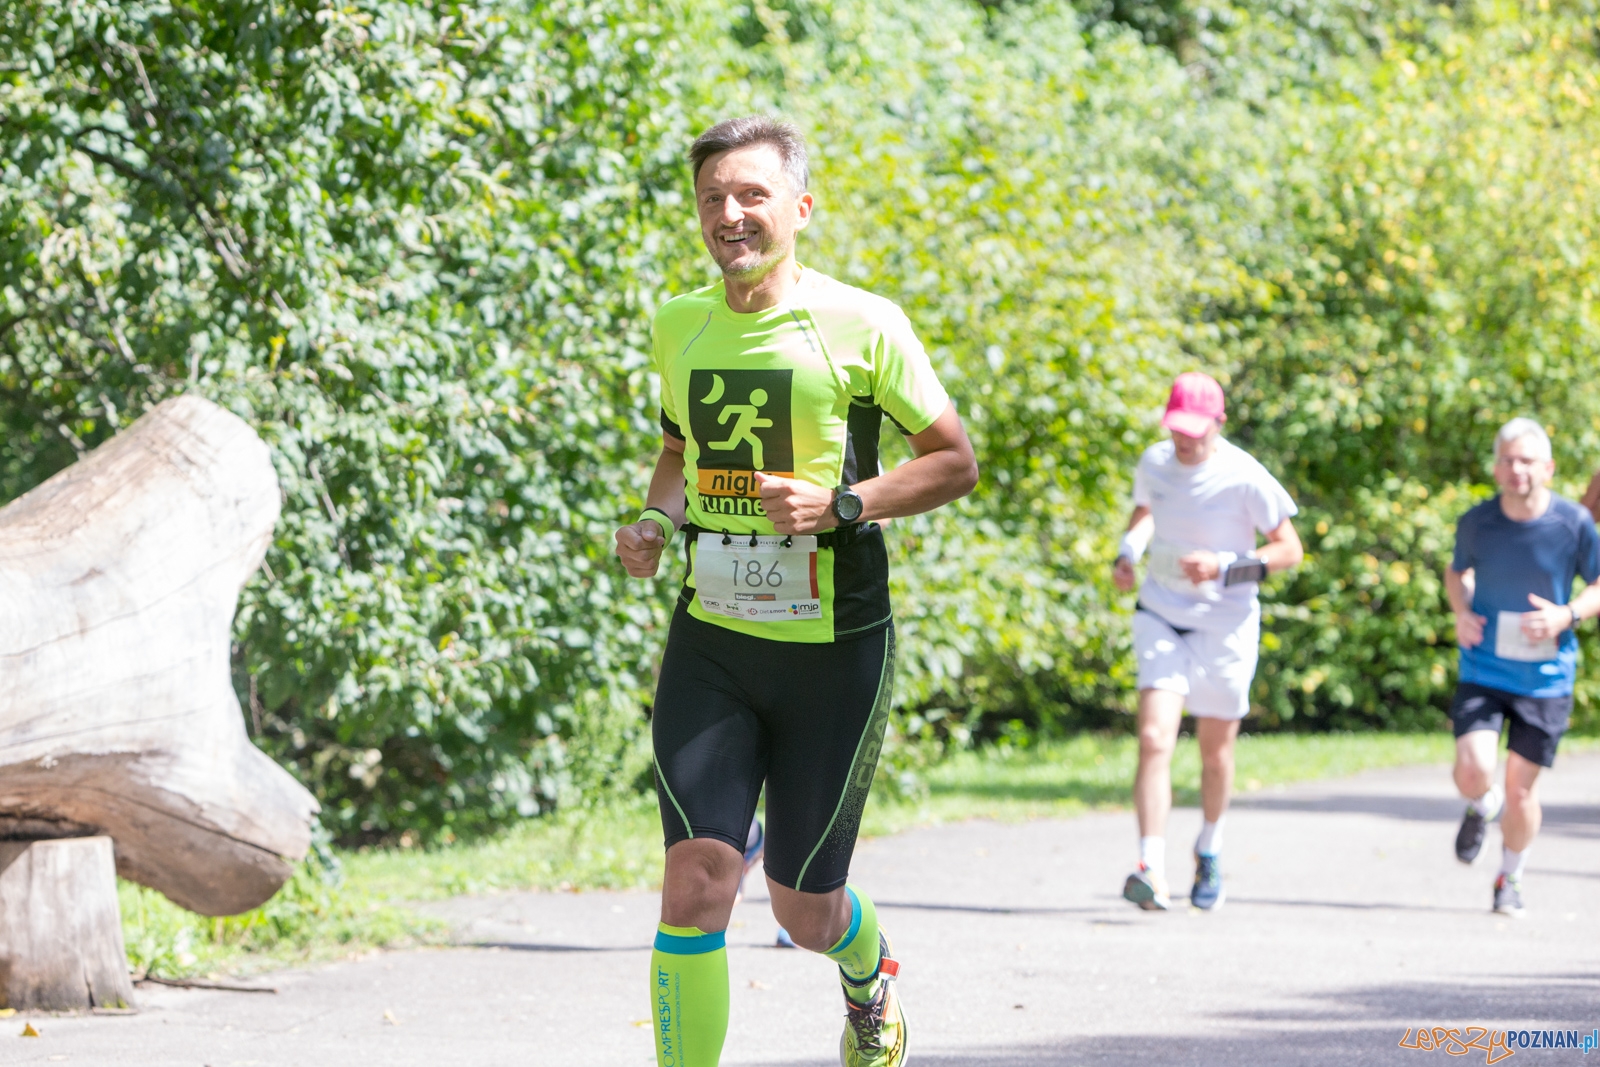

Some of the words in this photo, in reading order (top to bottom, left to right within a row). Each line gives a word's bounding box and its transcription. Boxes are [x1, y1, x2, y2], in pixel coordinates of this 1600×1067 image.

[711, 470, 772, 496] nigh
[699, 495, 767, 516] runne
[731, 559, 783, 588] 186
[799, 603, 819, 612] mjp
[855, 673, 892, 789] CRAFT
